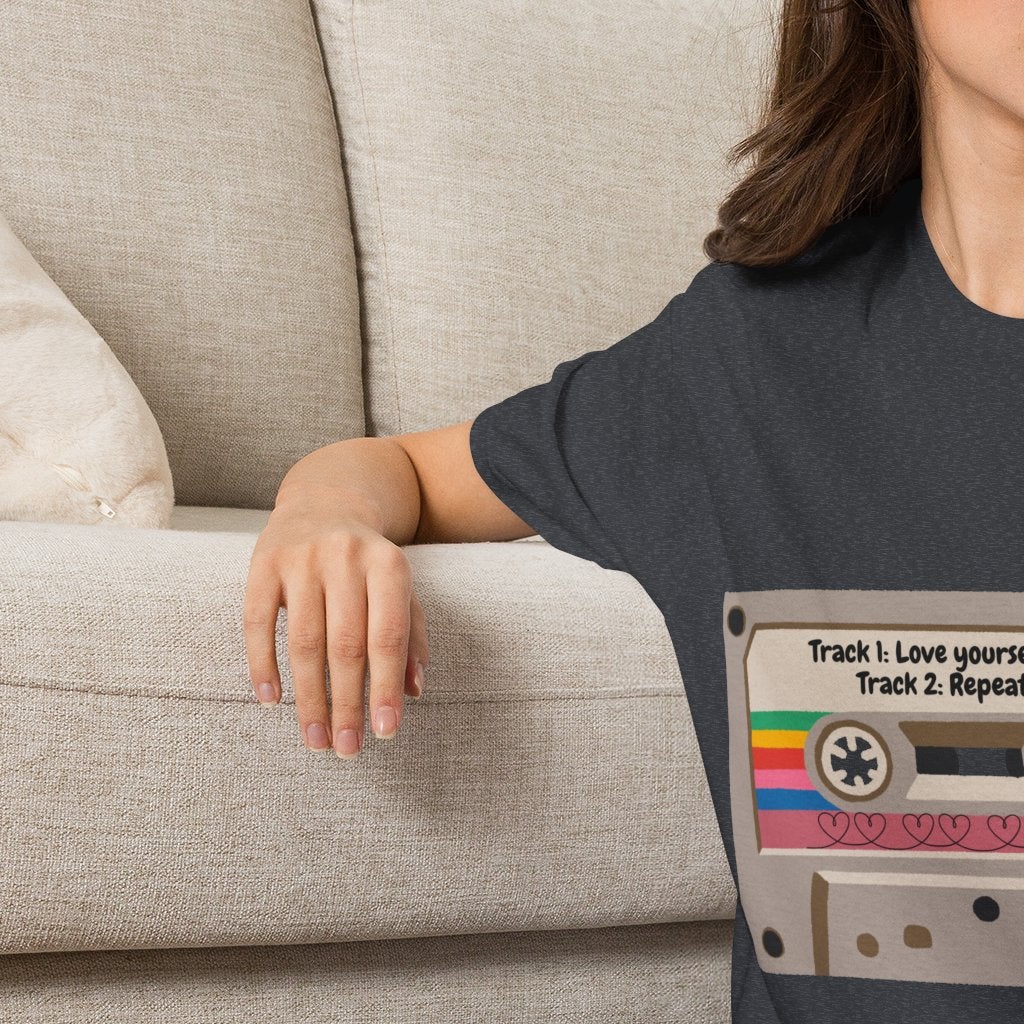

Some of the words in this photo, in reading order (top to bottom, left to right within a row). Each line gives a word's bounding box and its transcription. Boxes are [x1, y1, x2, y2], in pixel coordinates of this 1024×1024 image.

[808, 638, 870, 663] Track
[895, 640, 948, 664] Love
[856, 671, 918, 695] Track
[924, 672, 943, 696] 2:
